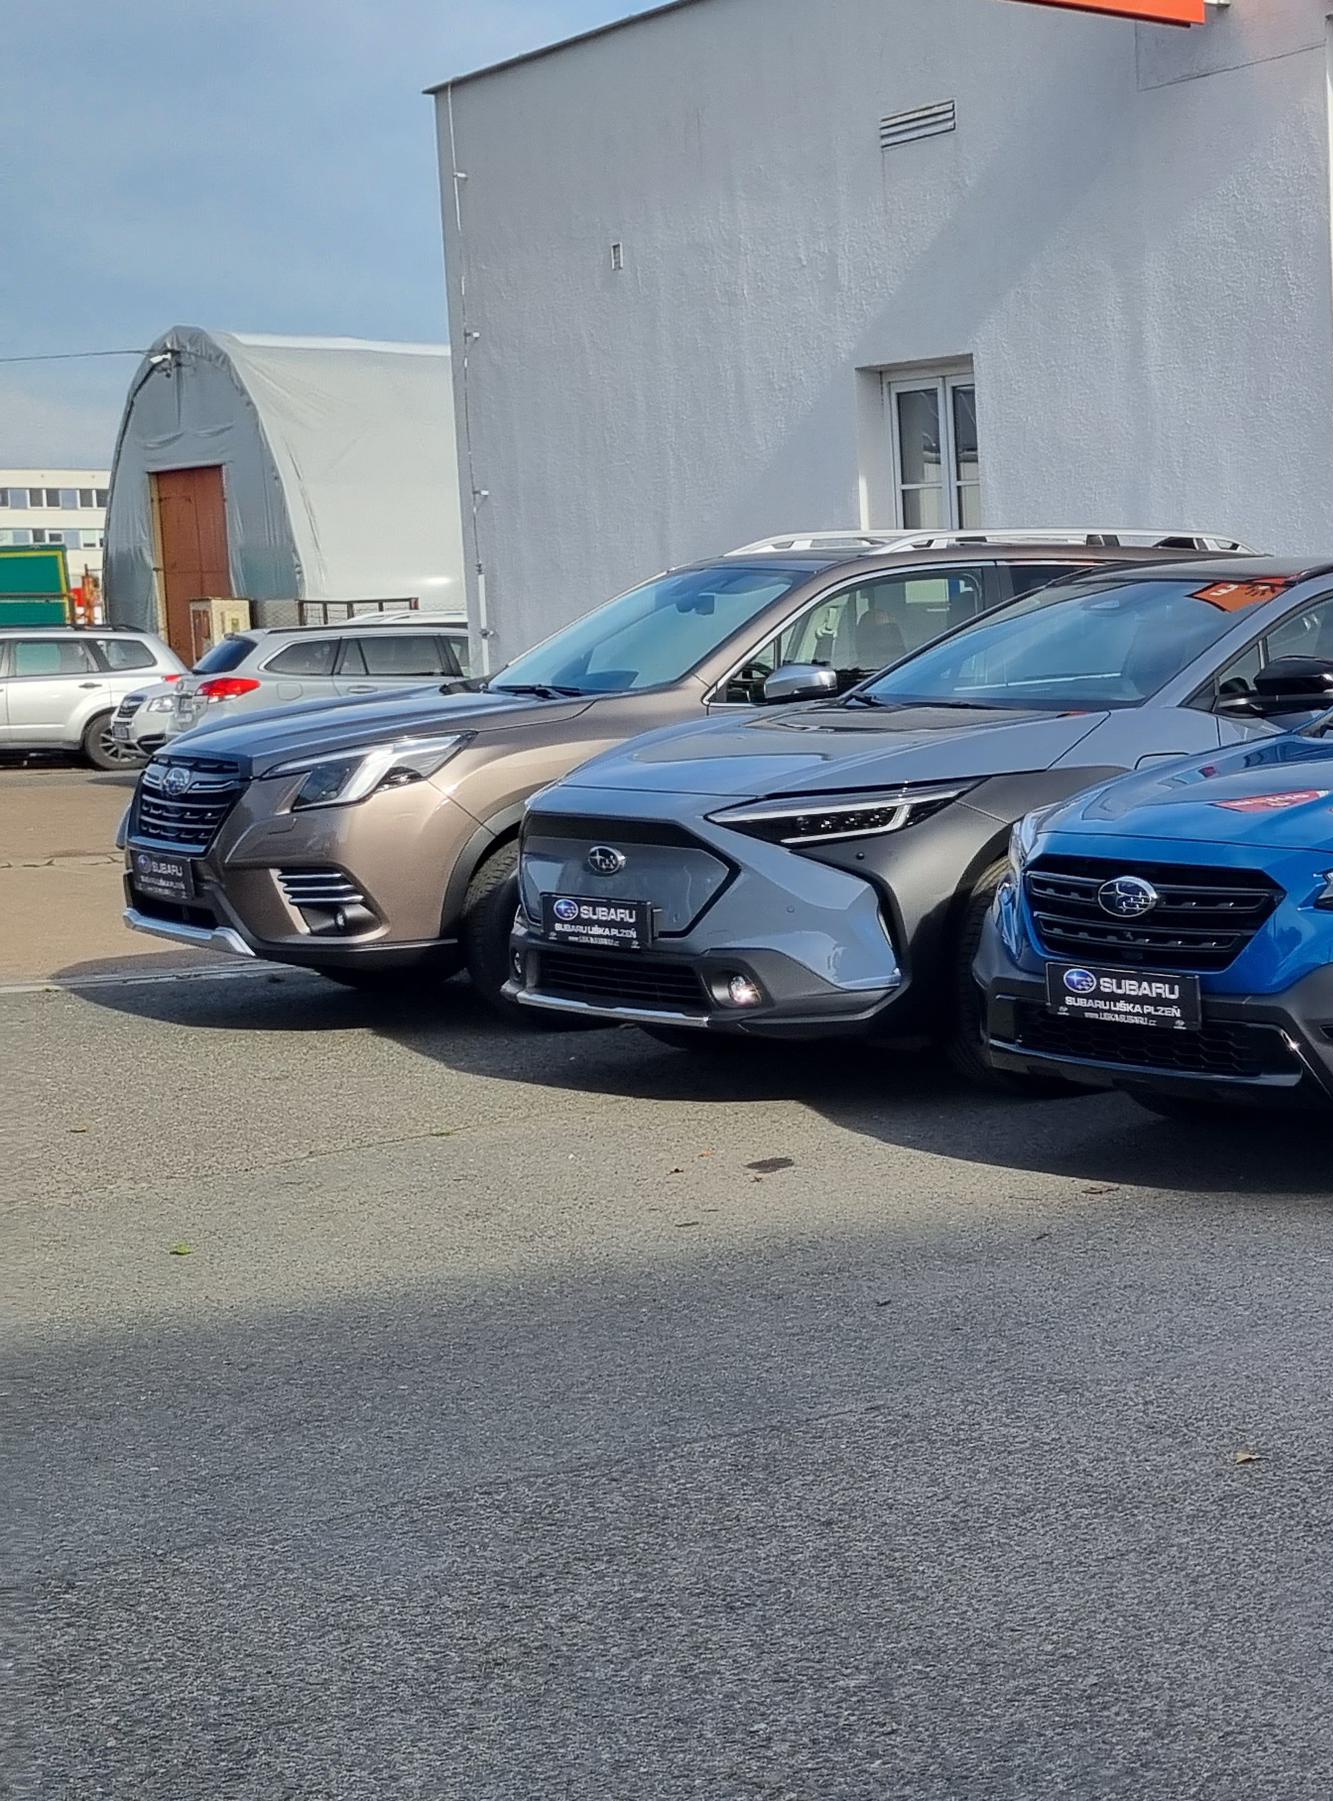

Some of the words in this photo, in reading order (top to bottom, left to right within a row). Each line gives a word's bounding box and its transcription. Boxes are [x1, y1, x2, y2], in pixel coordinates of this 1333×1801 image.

[580, 904, 636, 923] SUBARU
[554, 922, 588, 934] SUBARU
[1100, 976, 1180, 1000] SUBARU
[1064, 995, 1110, 1010] SUBARU
[1111, 1000, 1143, 1014] LIŠKA
[1143, 1004, 1182, 1018] PLZEŇ
